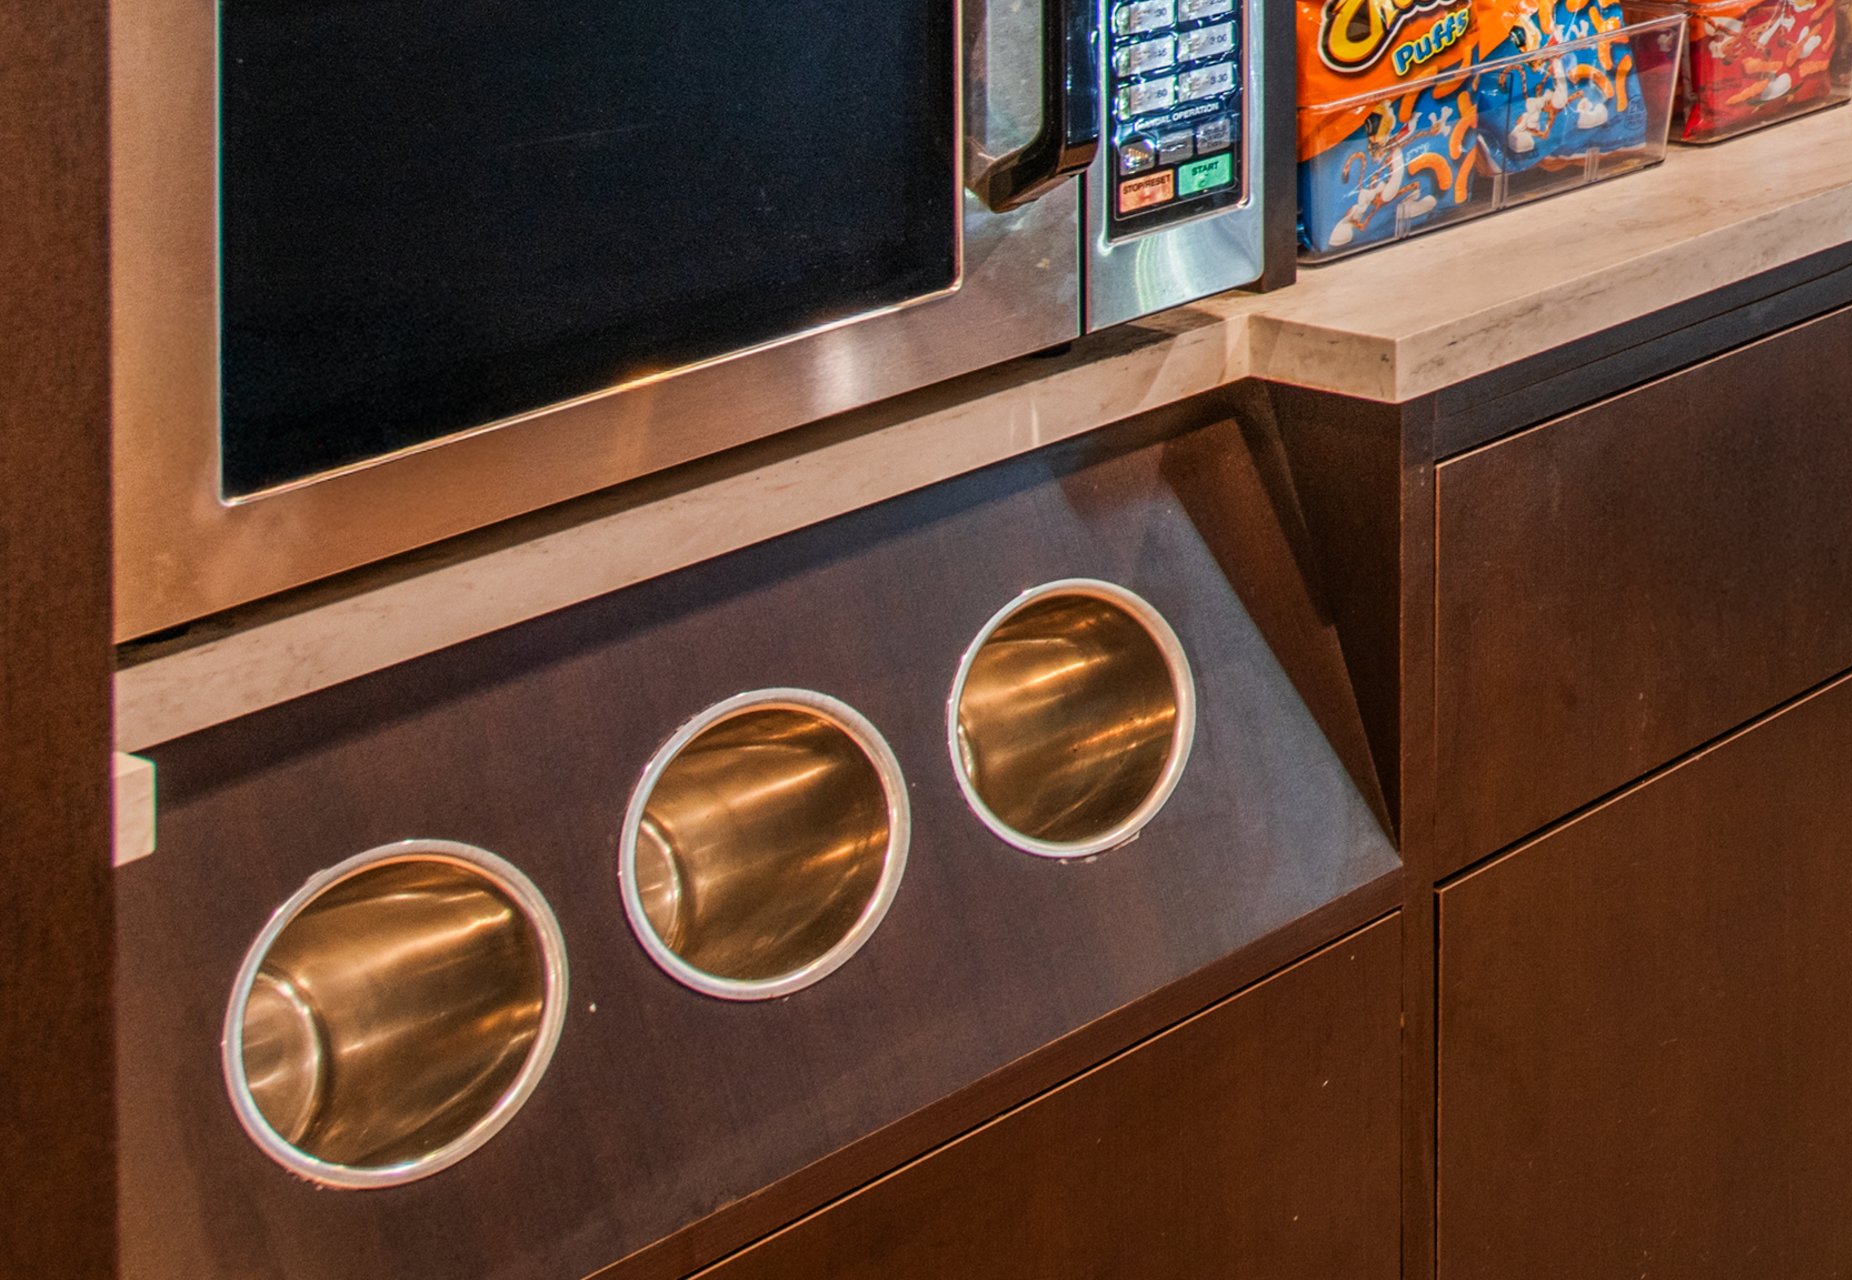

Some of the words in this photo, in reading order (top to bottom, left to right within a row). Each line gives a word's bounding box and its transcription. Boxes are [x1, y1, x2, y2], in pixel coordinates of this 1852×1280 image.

[1393, 6, 1470, 76] Puffs
[1191, 160, 1220, 177] START
[1122, 173, 1172, 195] STOP/RESET
